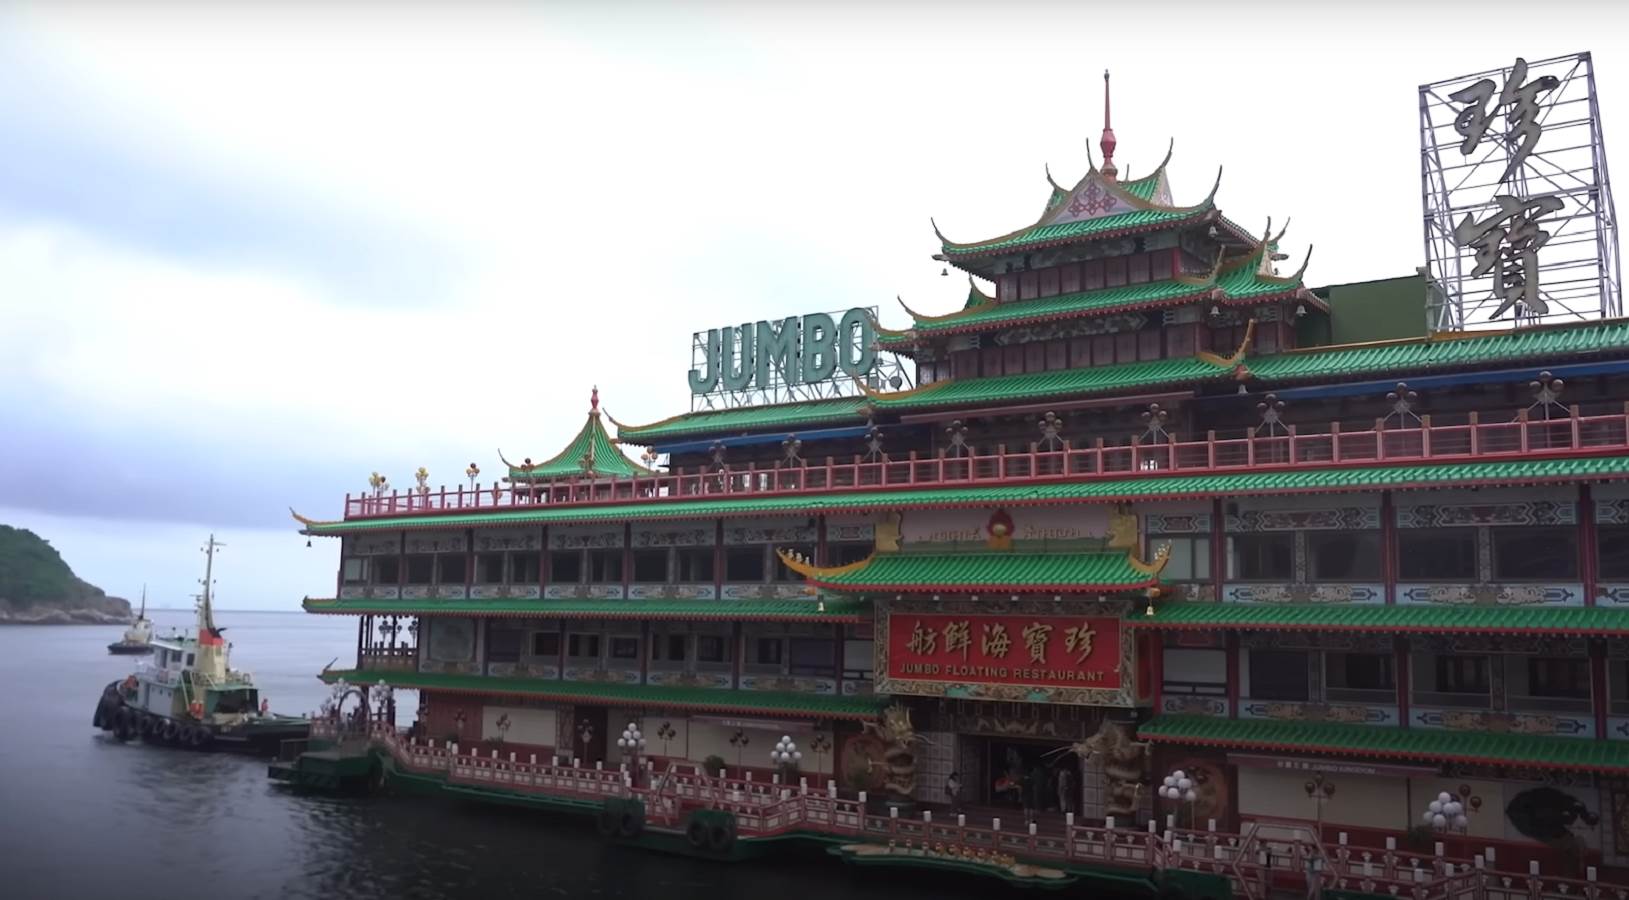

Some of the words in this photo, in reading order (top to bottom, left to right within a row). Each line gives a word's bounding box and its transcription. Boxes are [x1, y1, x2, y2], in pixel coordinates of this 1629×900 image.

[688, 307, 877, 394] JUMBO
[900, 663, 940, 675] JUMBO
[946, 666, 1008, 678] FLOATING
[1013, 668, 1105, 681] RESTAURANT
